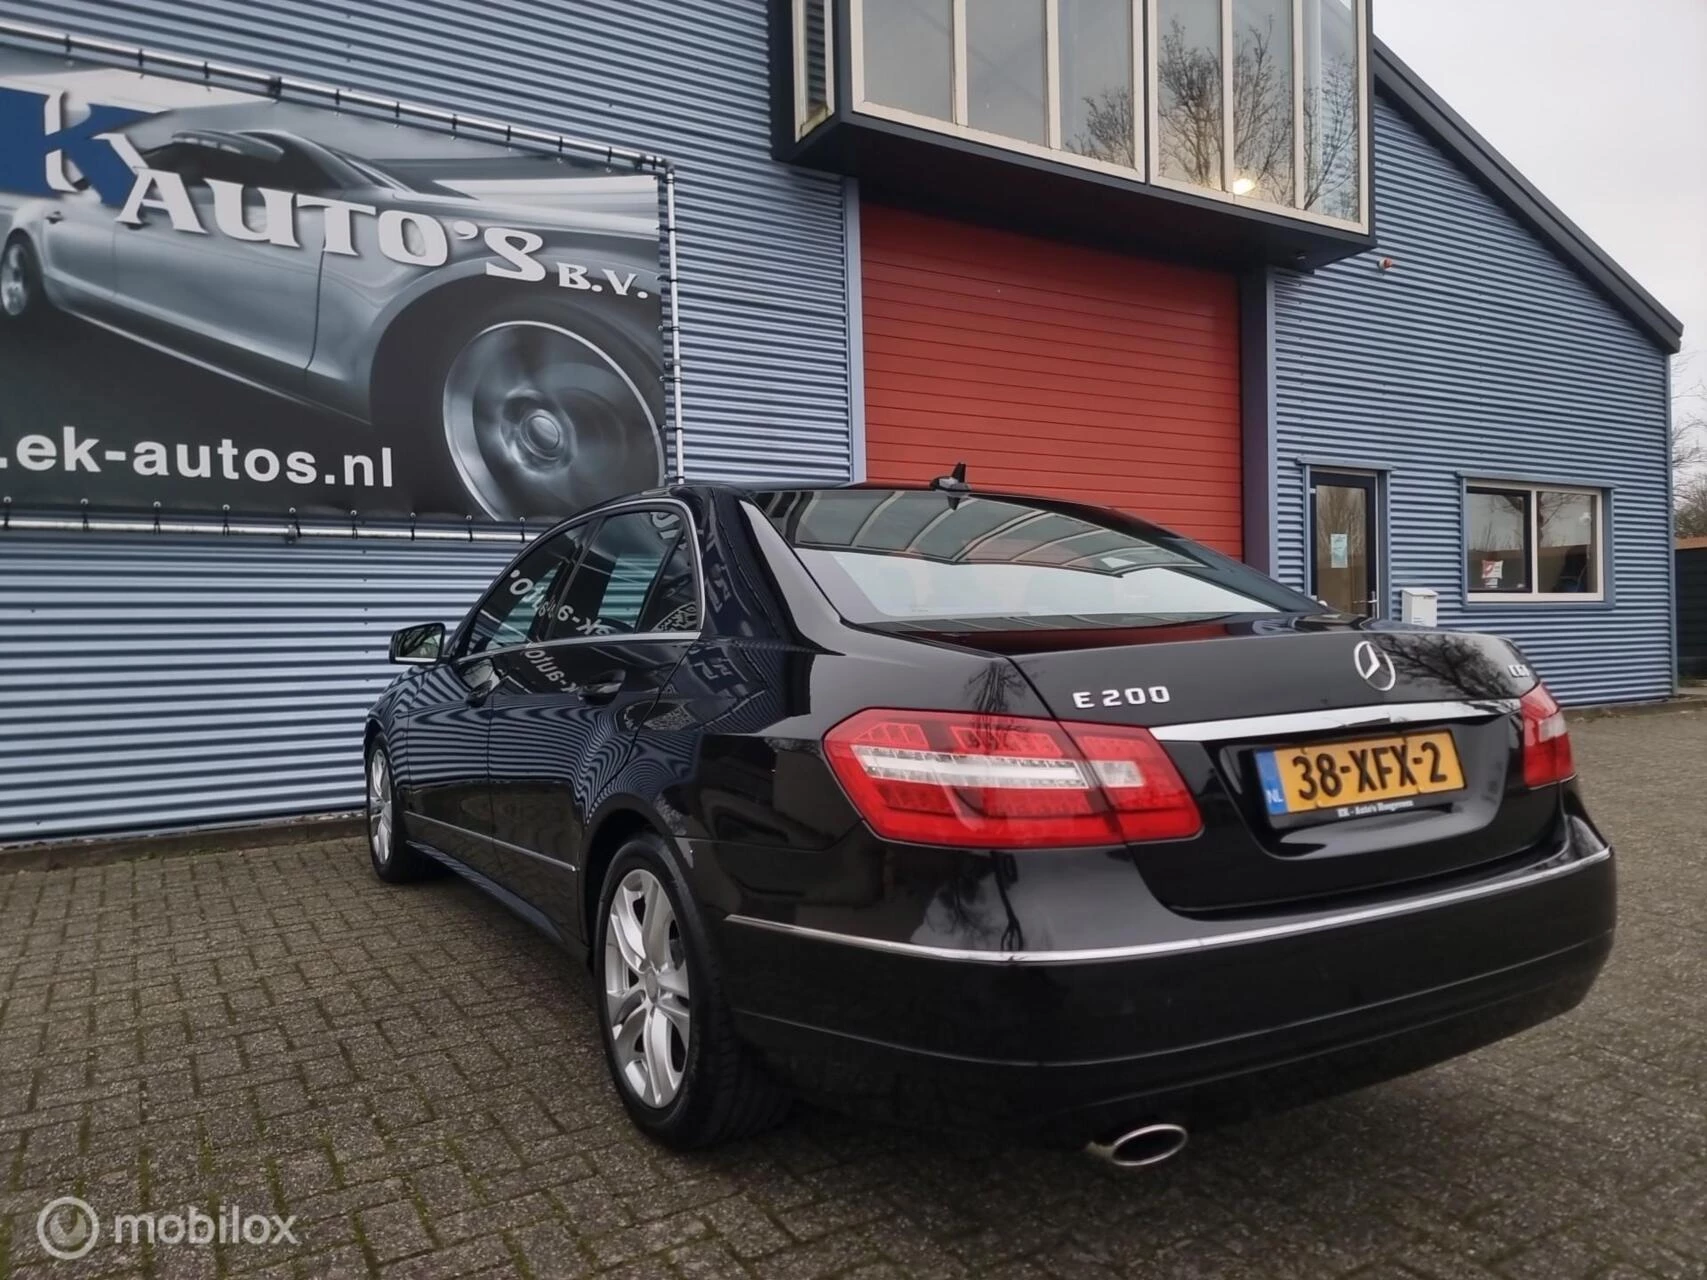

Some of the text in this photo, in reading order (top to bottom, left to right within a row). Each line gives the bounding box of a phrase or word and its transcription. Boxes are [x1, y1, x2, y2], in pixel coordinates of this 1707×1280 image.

[556, 261, 648, 299] B.V.
[1073, 685, 1171, 709] E 200
[1292, 741, 1448, 801] 38-XFX-2
[1265, 788, 1284, 804] NL
